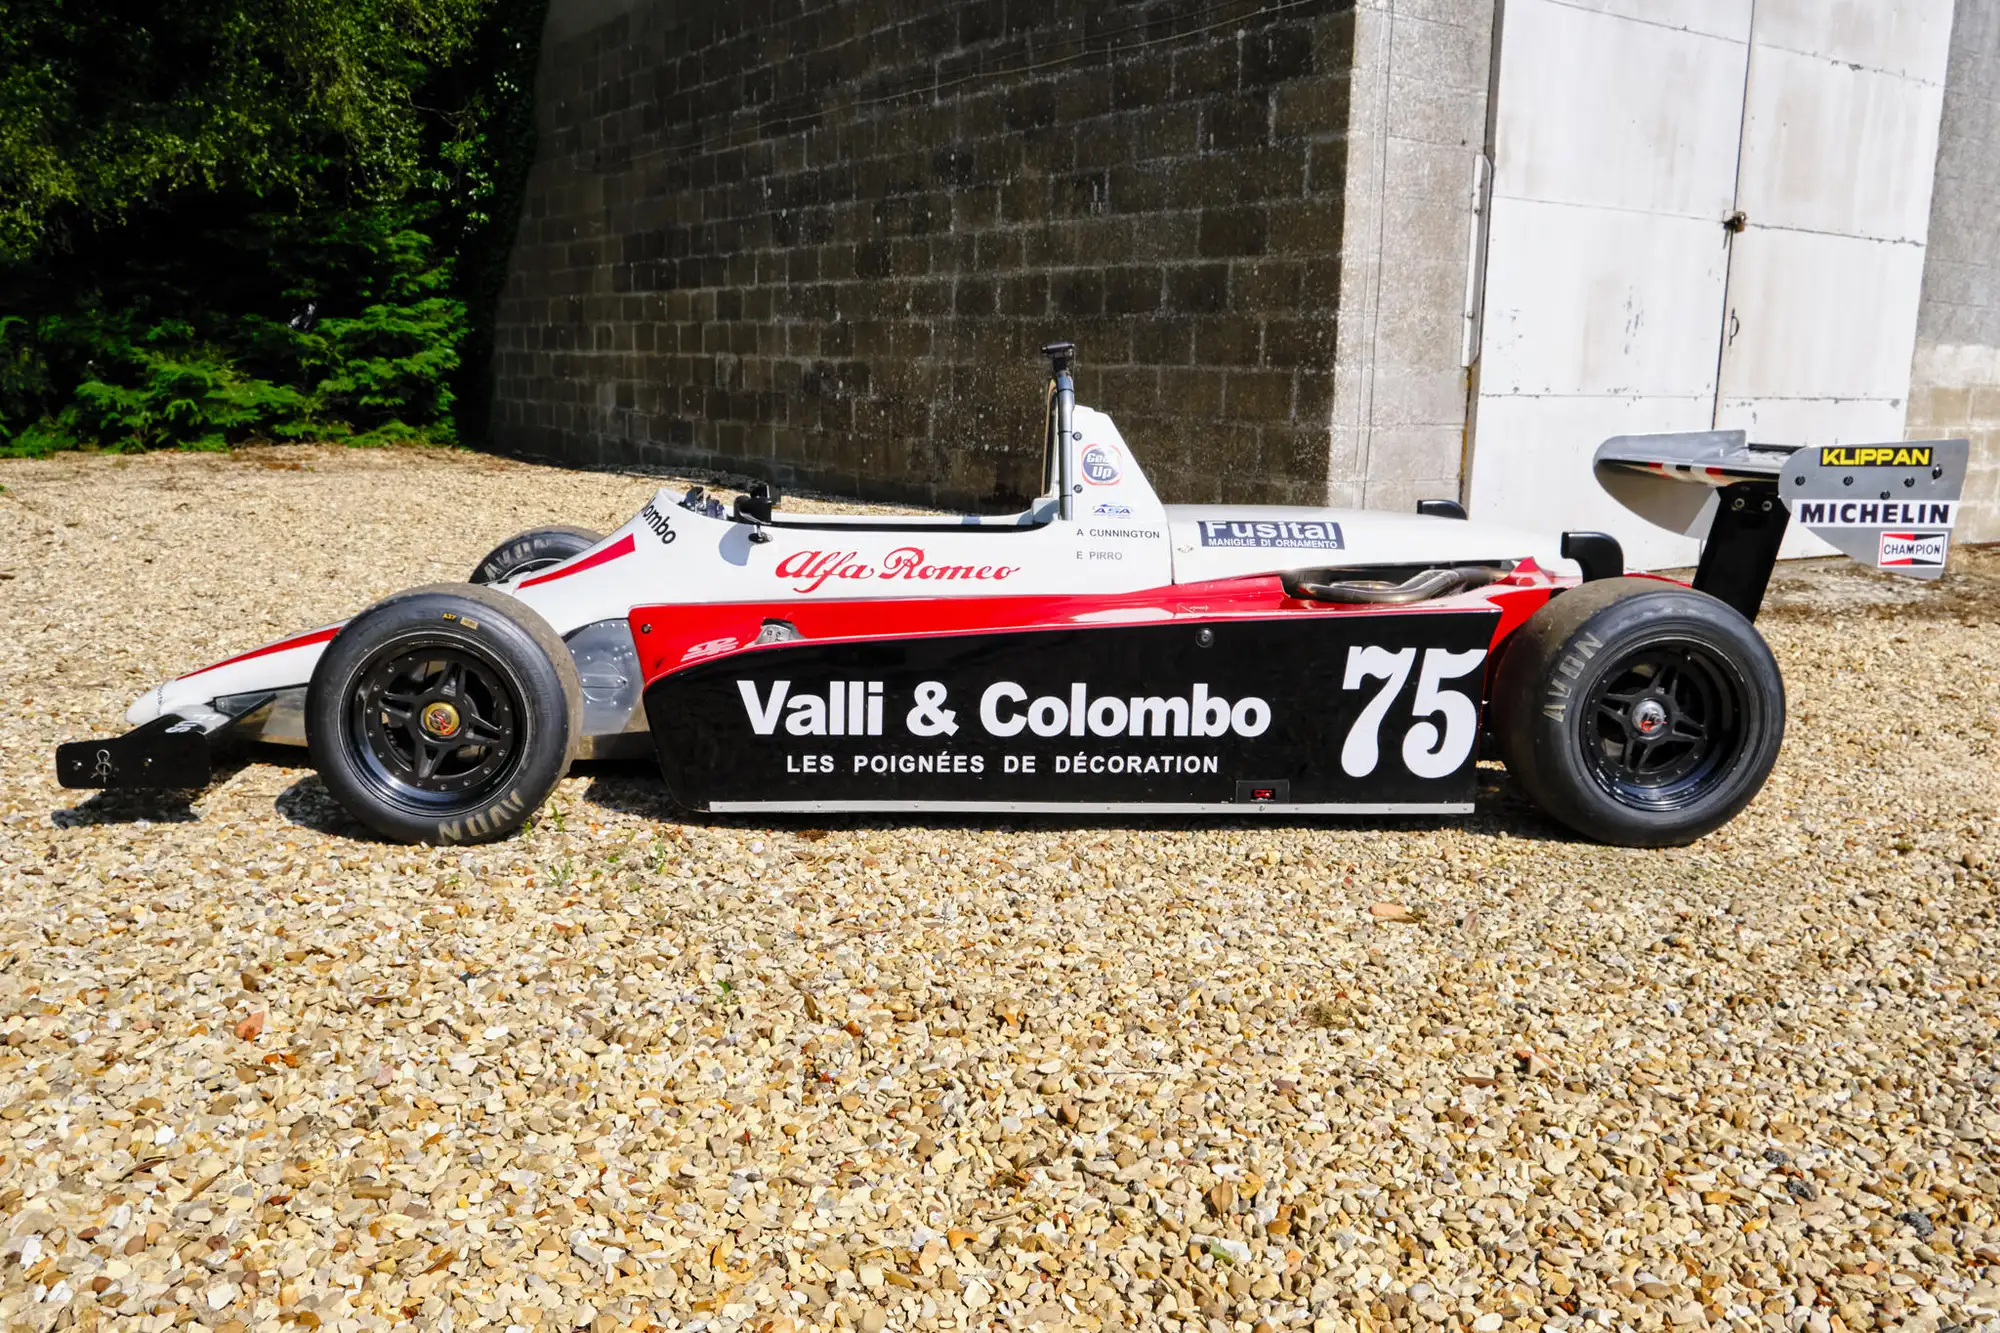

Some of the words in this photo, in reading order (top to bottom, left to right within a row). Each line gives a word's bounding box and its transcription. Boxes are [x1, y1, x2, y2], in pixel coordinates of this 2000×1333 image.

[1821, 448, 1931, 466] KLIPPAN
[1800, 503, 1950, 524] MICHELIN
[1076, 528, 1084, 537] A
[1089, 528, 1160, 539] CUNNINGTON
[1204, 520, 1337, 540] Fusital
[1208, 538, 1257, 547] MANIGLIE
[1261, 538, 1271, 547] DI
[1275, 539, 1338, 549] ORNAMENTO
[1883, 543, 1941, 556] CHAMPION
[1076, 551, 1083, 560] E
[1089, 551, 1123, 561] PIRRO
[775, 550, 875, 593] Alfa
[878, 546, 1022, 580] Romeo
[1541, 631, 1604, 724] AVON
[737, 680, 884, 737] Valli
[906, 681, 959, 737] &
[980, 682, 1272, 739] Colombo
[1340, 645, 1488, 779] 75
[786, 755, 835, 774] LES
[853, 751, 986, 774] POIGNÉES
[1004, 755, 1037, 774] DE
[1055, 751, 1219, 774] DÉCORATION
[438, 788, 525, 842] AVON
